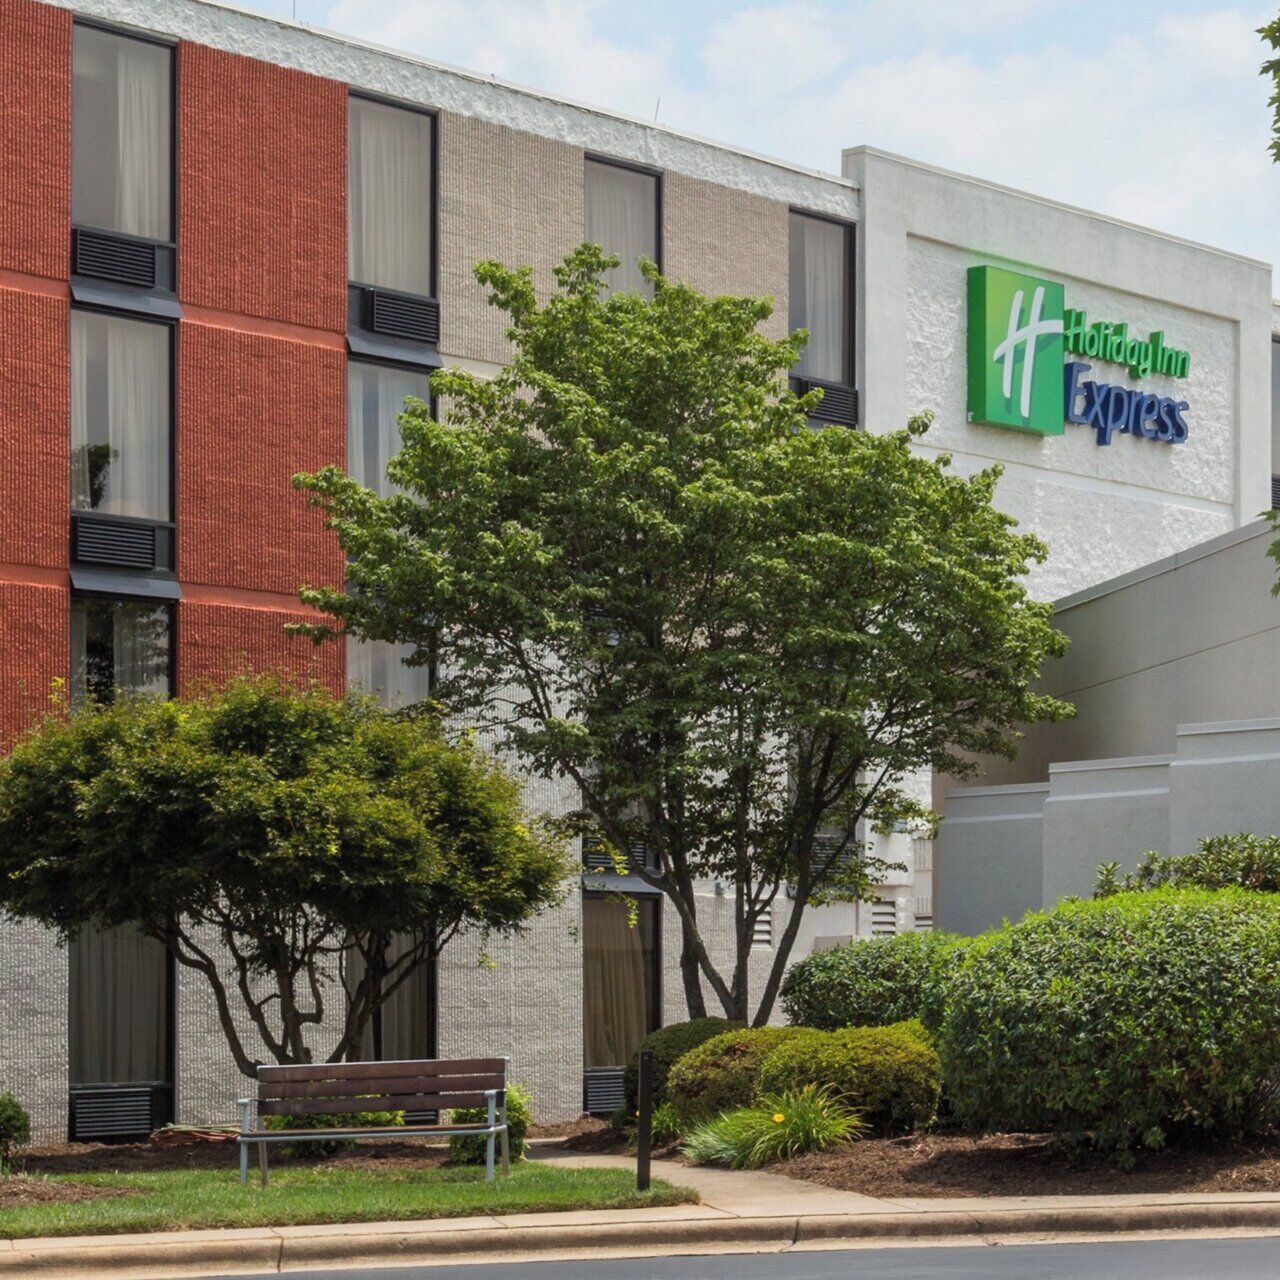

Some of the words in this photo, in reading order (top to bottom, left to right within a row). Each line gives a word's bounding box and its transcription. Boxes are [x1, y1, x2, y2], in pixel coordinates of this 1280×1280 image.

[1064, 308, 1153, 380] Holiday
[1153, 331, 1191, 379] Inn
[1064, 361, 1190, 446] Express
